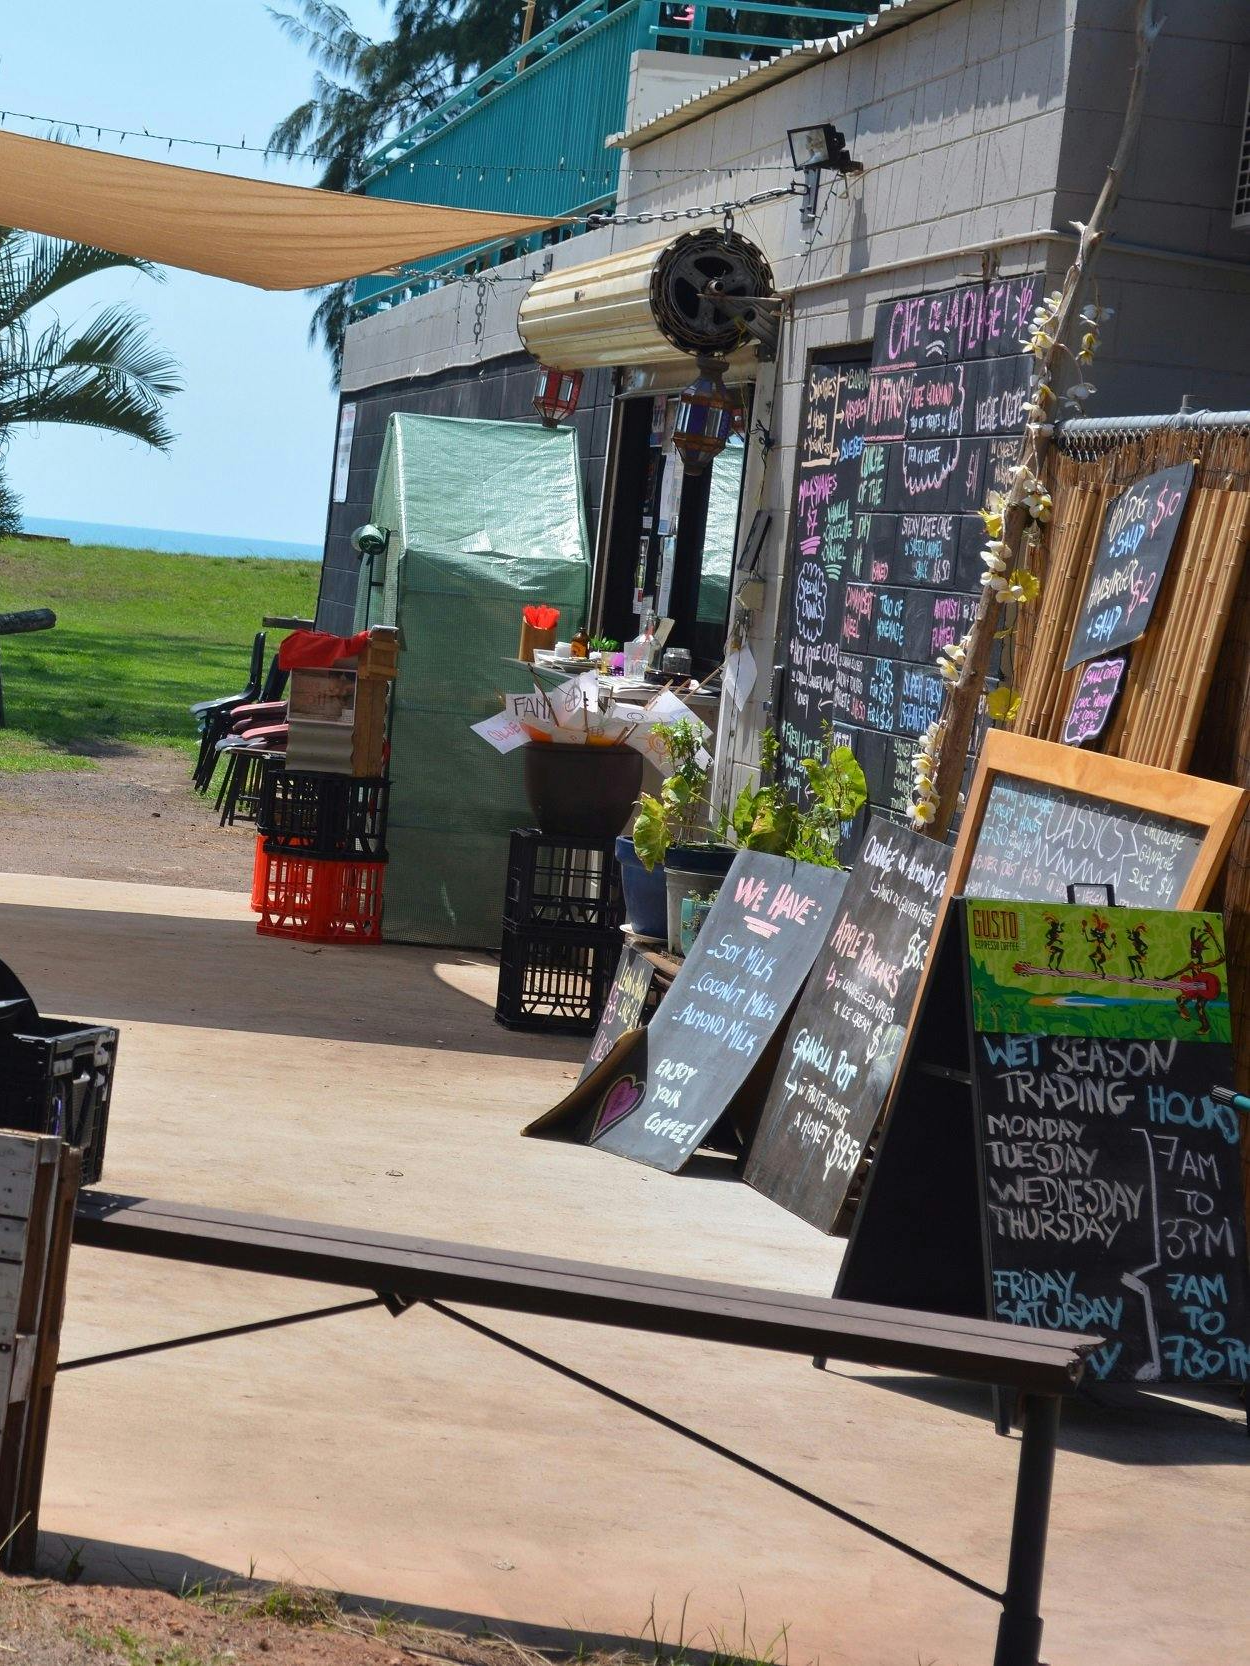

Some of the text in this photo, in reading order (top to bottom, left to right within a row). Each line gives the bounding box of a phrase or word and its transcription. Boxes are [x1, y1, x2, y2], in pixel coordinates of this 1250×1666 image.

[889, 299, 925, 360] CAFE
[944, 291, 959, 328] LA
[866, 376, 903, 426] MUFFINS
[858, 479, 883, 506] OF THE
[1150, 479, 1181, 539] $10
[920, 516, 937, 539] DATE
[1115, 523, 1146, 558] SALAD
[1087, 558, 1139, 614] HAMBURGER
[1092, 605, 1122, 643] SALAD
[514, 696, 551, 719] FAN
[1144, 820, 1190, 852] CHOCOLATE
[864, 835, 899, 880] ORANGE
[904, 855, 935, 893] ALMOND
[932, 871, 947, 898] CA
[733, 876, 769, 914] WE
[1157, 873, 1174, 904] $4
[897, 895, 921, 920] GLUTEN
[917, 901, 936, 928] FREE
[973, 909, 1019, 940] GUSTO
[713, 934, 777, 982] SOY MILK
[830, 911, 901, 999] APPLE PANCAKES
[697, 972, 778, 1021] COCONUT MILK
[872, 999, 896, 1023] APPLES
[679, 1003, 726, 1039] ALMOND
[725, 1022, 762, 1057] MILK
[840, 1004, 853, 1021] ICE
[852, 1012, 873, 1036] CREAM
[653, 1058, 699, 1086] ENJOY
[792, 1028, 859, 1092] GRANOLA POT
[982, 1031, 1177, 1080] WET SEASON
[651, 1084, 681, 1109] YOUR
[994, 1070, 1136, 1116] TRADING
[800, 1113, 834, 1150] HONEY
[986, 1113, 1087, 1143] MONDAY
[985, 1141, 1099, 1176] TUESDAY
[989, 1175, 1145, 1223] WEDNESDAY
[1175, 1188, 1214, 1216] TO
[987, 1203, 1123, 1249] THURSDAY
[1160, 1217, 1236, 1260] 3PM
[992, 1269, 1077, 1301] FRIDAY
[1165, 1272, 1228, 1307] 7AM
[996, 1292, 1124, 1331] SATURDAY
[1179, 1305, 1226, 1335] TO
